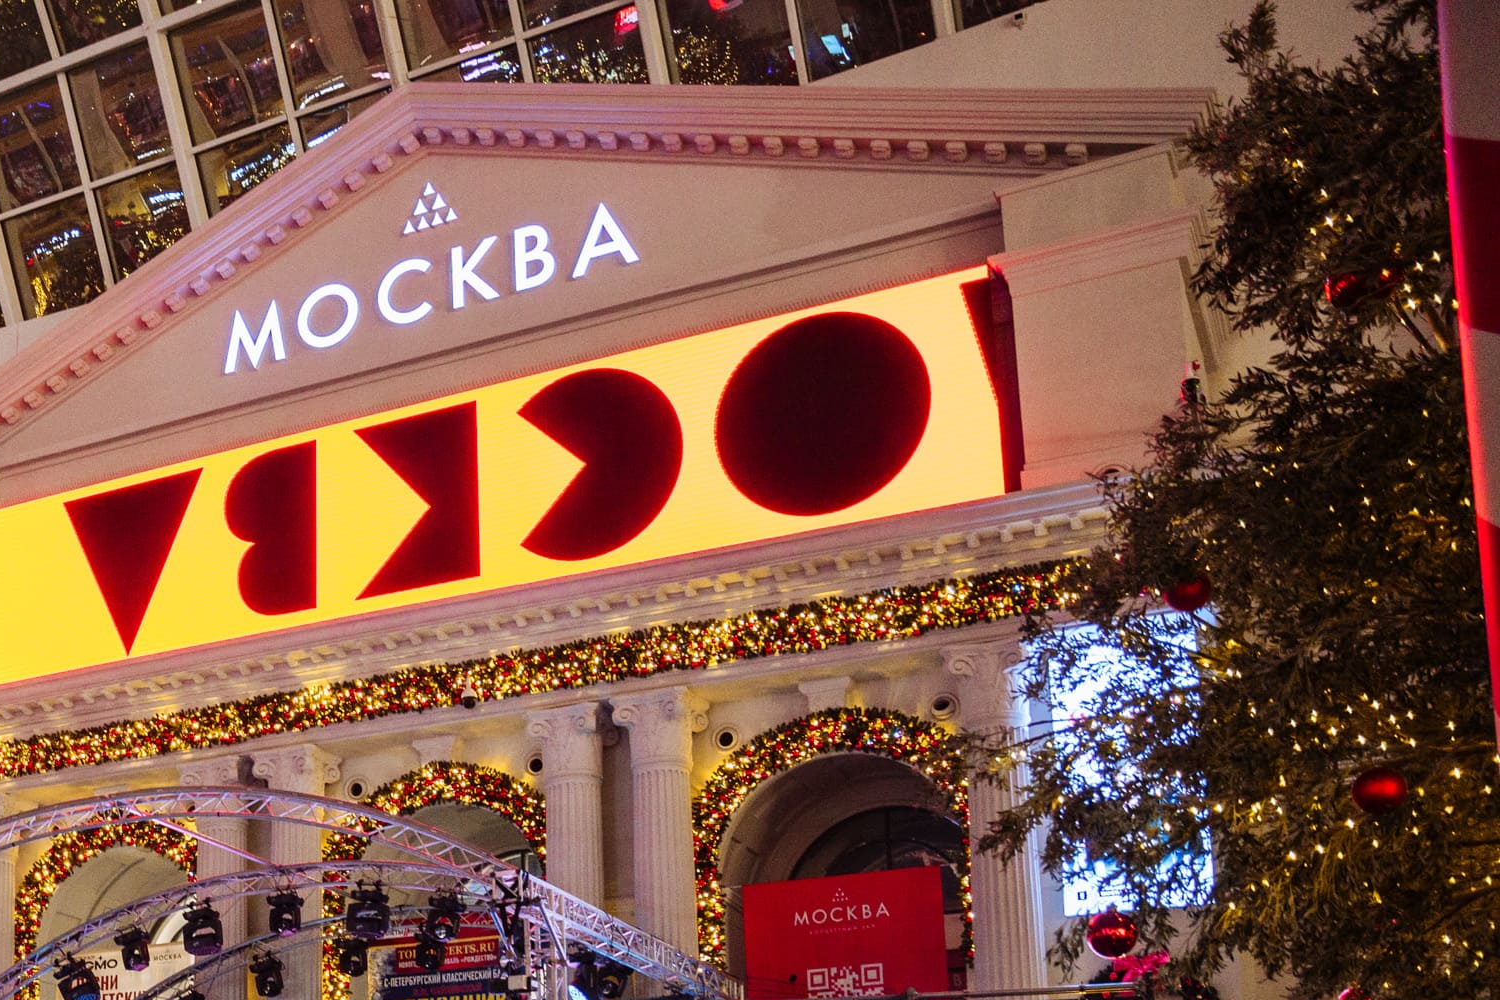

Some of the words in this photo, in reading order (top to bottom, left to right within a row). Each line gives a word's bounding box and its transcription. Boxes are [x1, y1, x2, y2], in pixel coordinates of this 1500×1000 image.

[223, 202, 640, 375] МОСКВА
[794, 902, 890, 927] МОСКВА
[398, 942, 495, 960] TOERTS.RU
